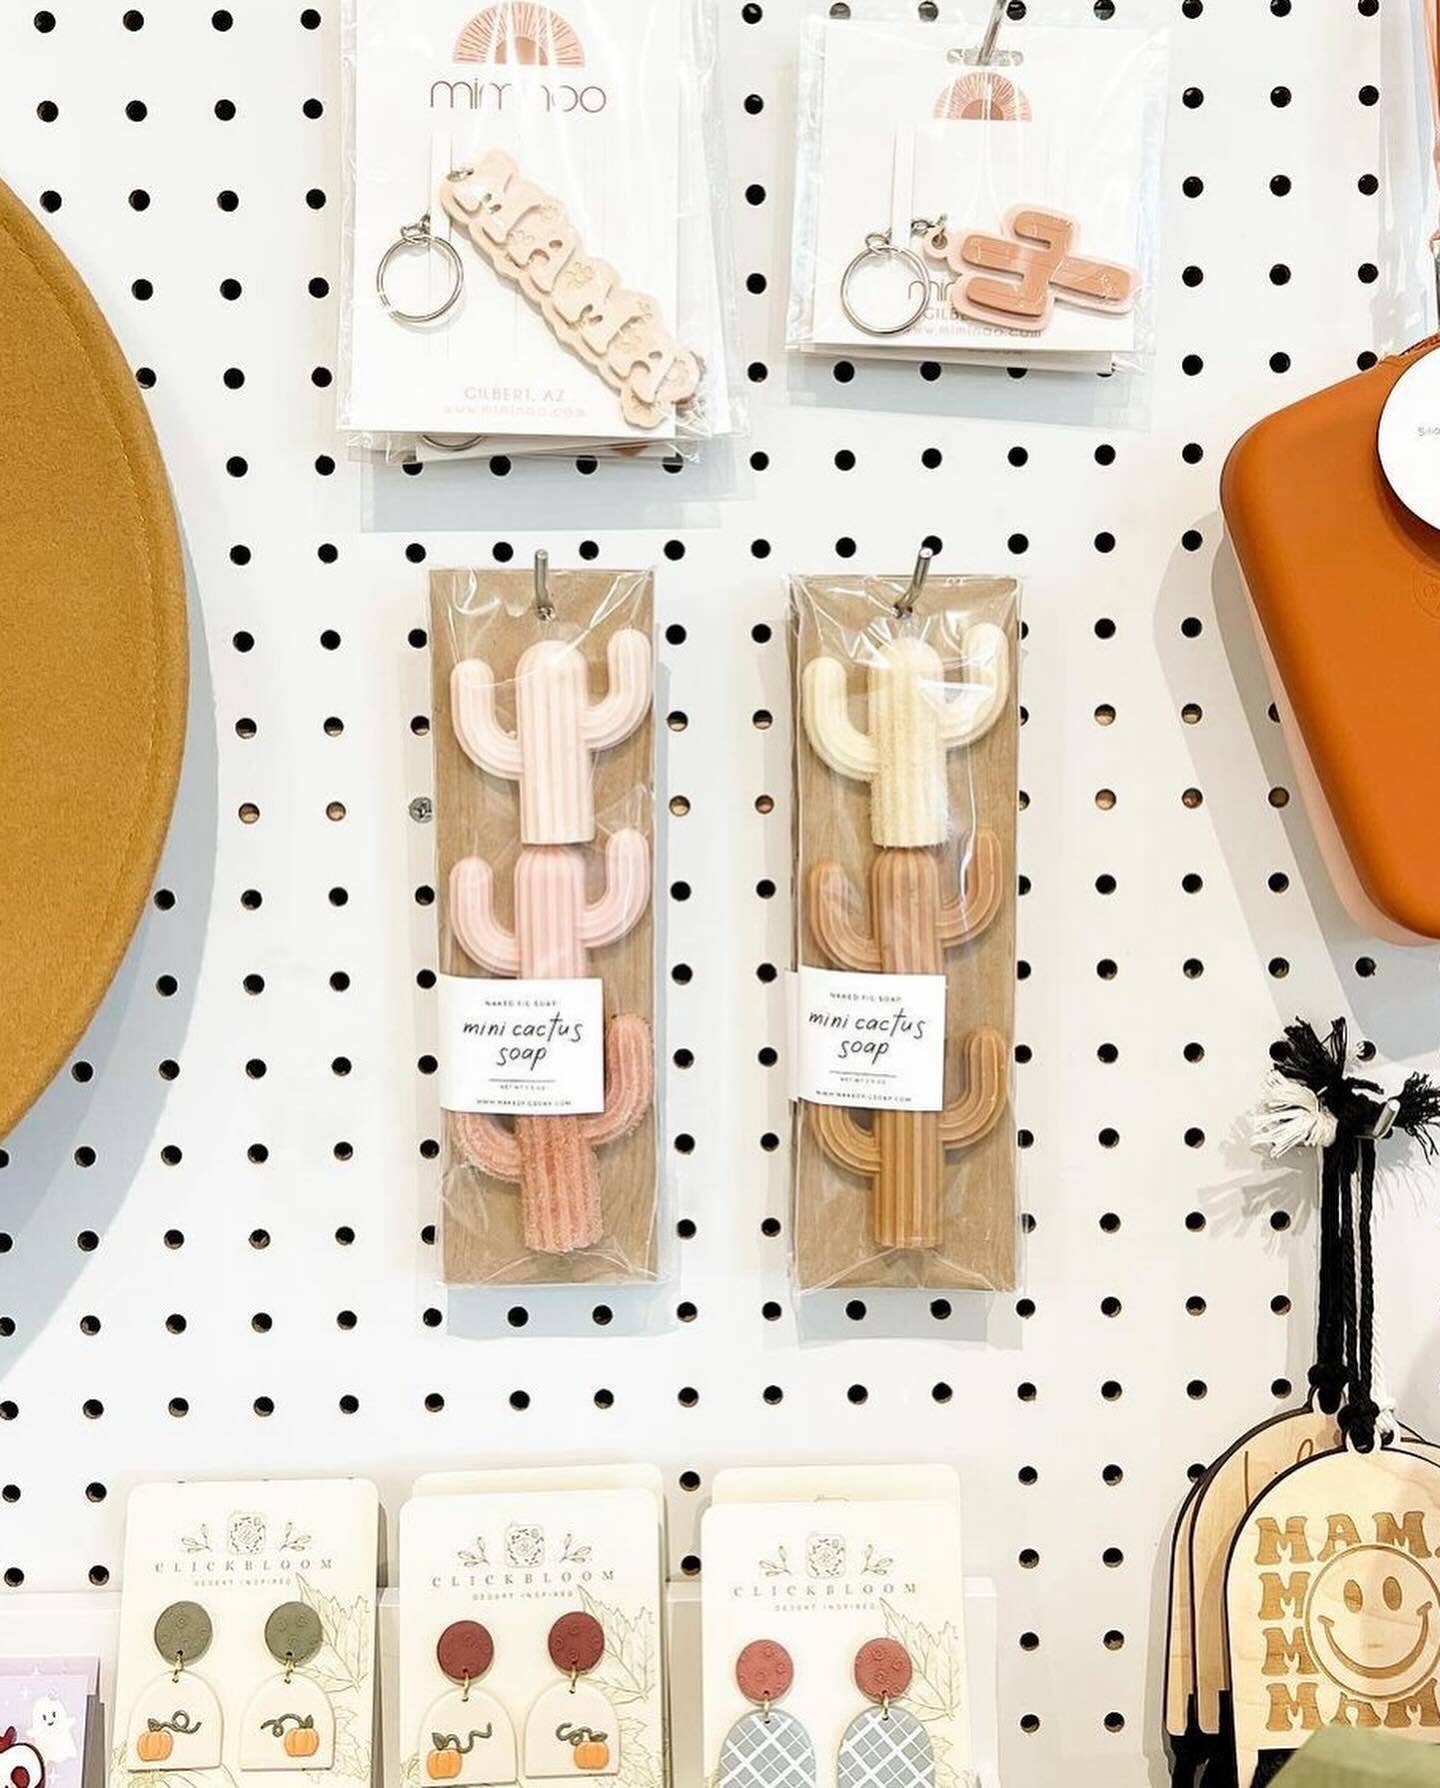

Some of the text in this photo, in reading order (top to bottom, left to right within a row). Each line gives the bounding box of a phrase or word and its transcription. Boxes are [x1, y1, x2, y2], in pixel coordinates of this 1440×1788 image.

[462, 1011, 584, 1043] mini cactus
[808, 1007, 927, 1040] mini cactus
[496, 1046, 548, 1072] soap
[837, 1040, 890, 1065] soap
[1254, 1510, 1440, 1565] MAM
[154, 1558, 332, 1574] CLICKBLOOM
[431, 1569, 614, 1589] CLICKBLOOM
[732, 1582, 917, 1598] CLICKBLOOM
